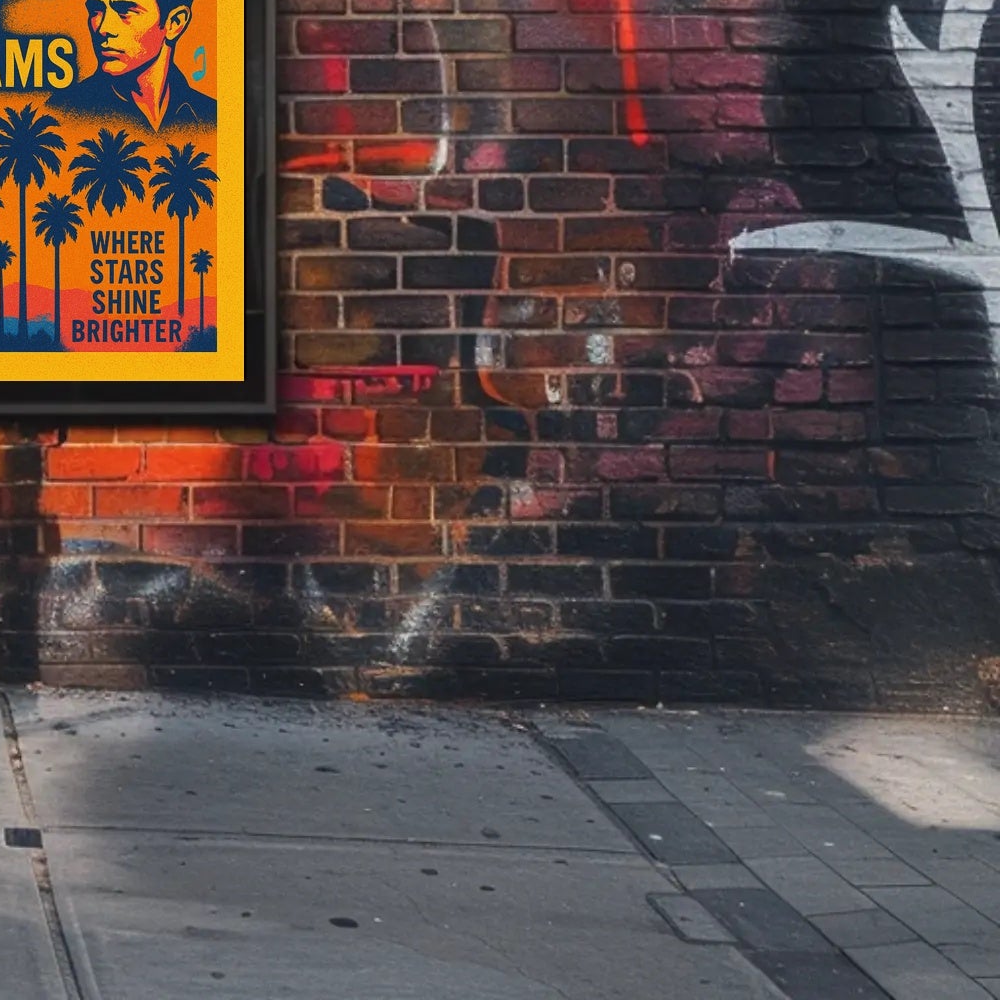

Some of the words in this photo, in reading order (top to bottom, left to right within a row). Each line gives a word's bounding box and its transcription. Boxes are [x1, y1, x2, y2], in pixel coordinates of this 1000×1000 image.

[90, 230, 165, 254] WHERE
[90, 259, 164, 285] STARS
[92, 289, 161, 315] SHINE
[71, 319, 182, 343] BRIGHTER
